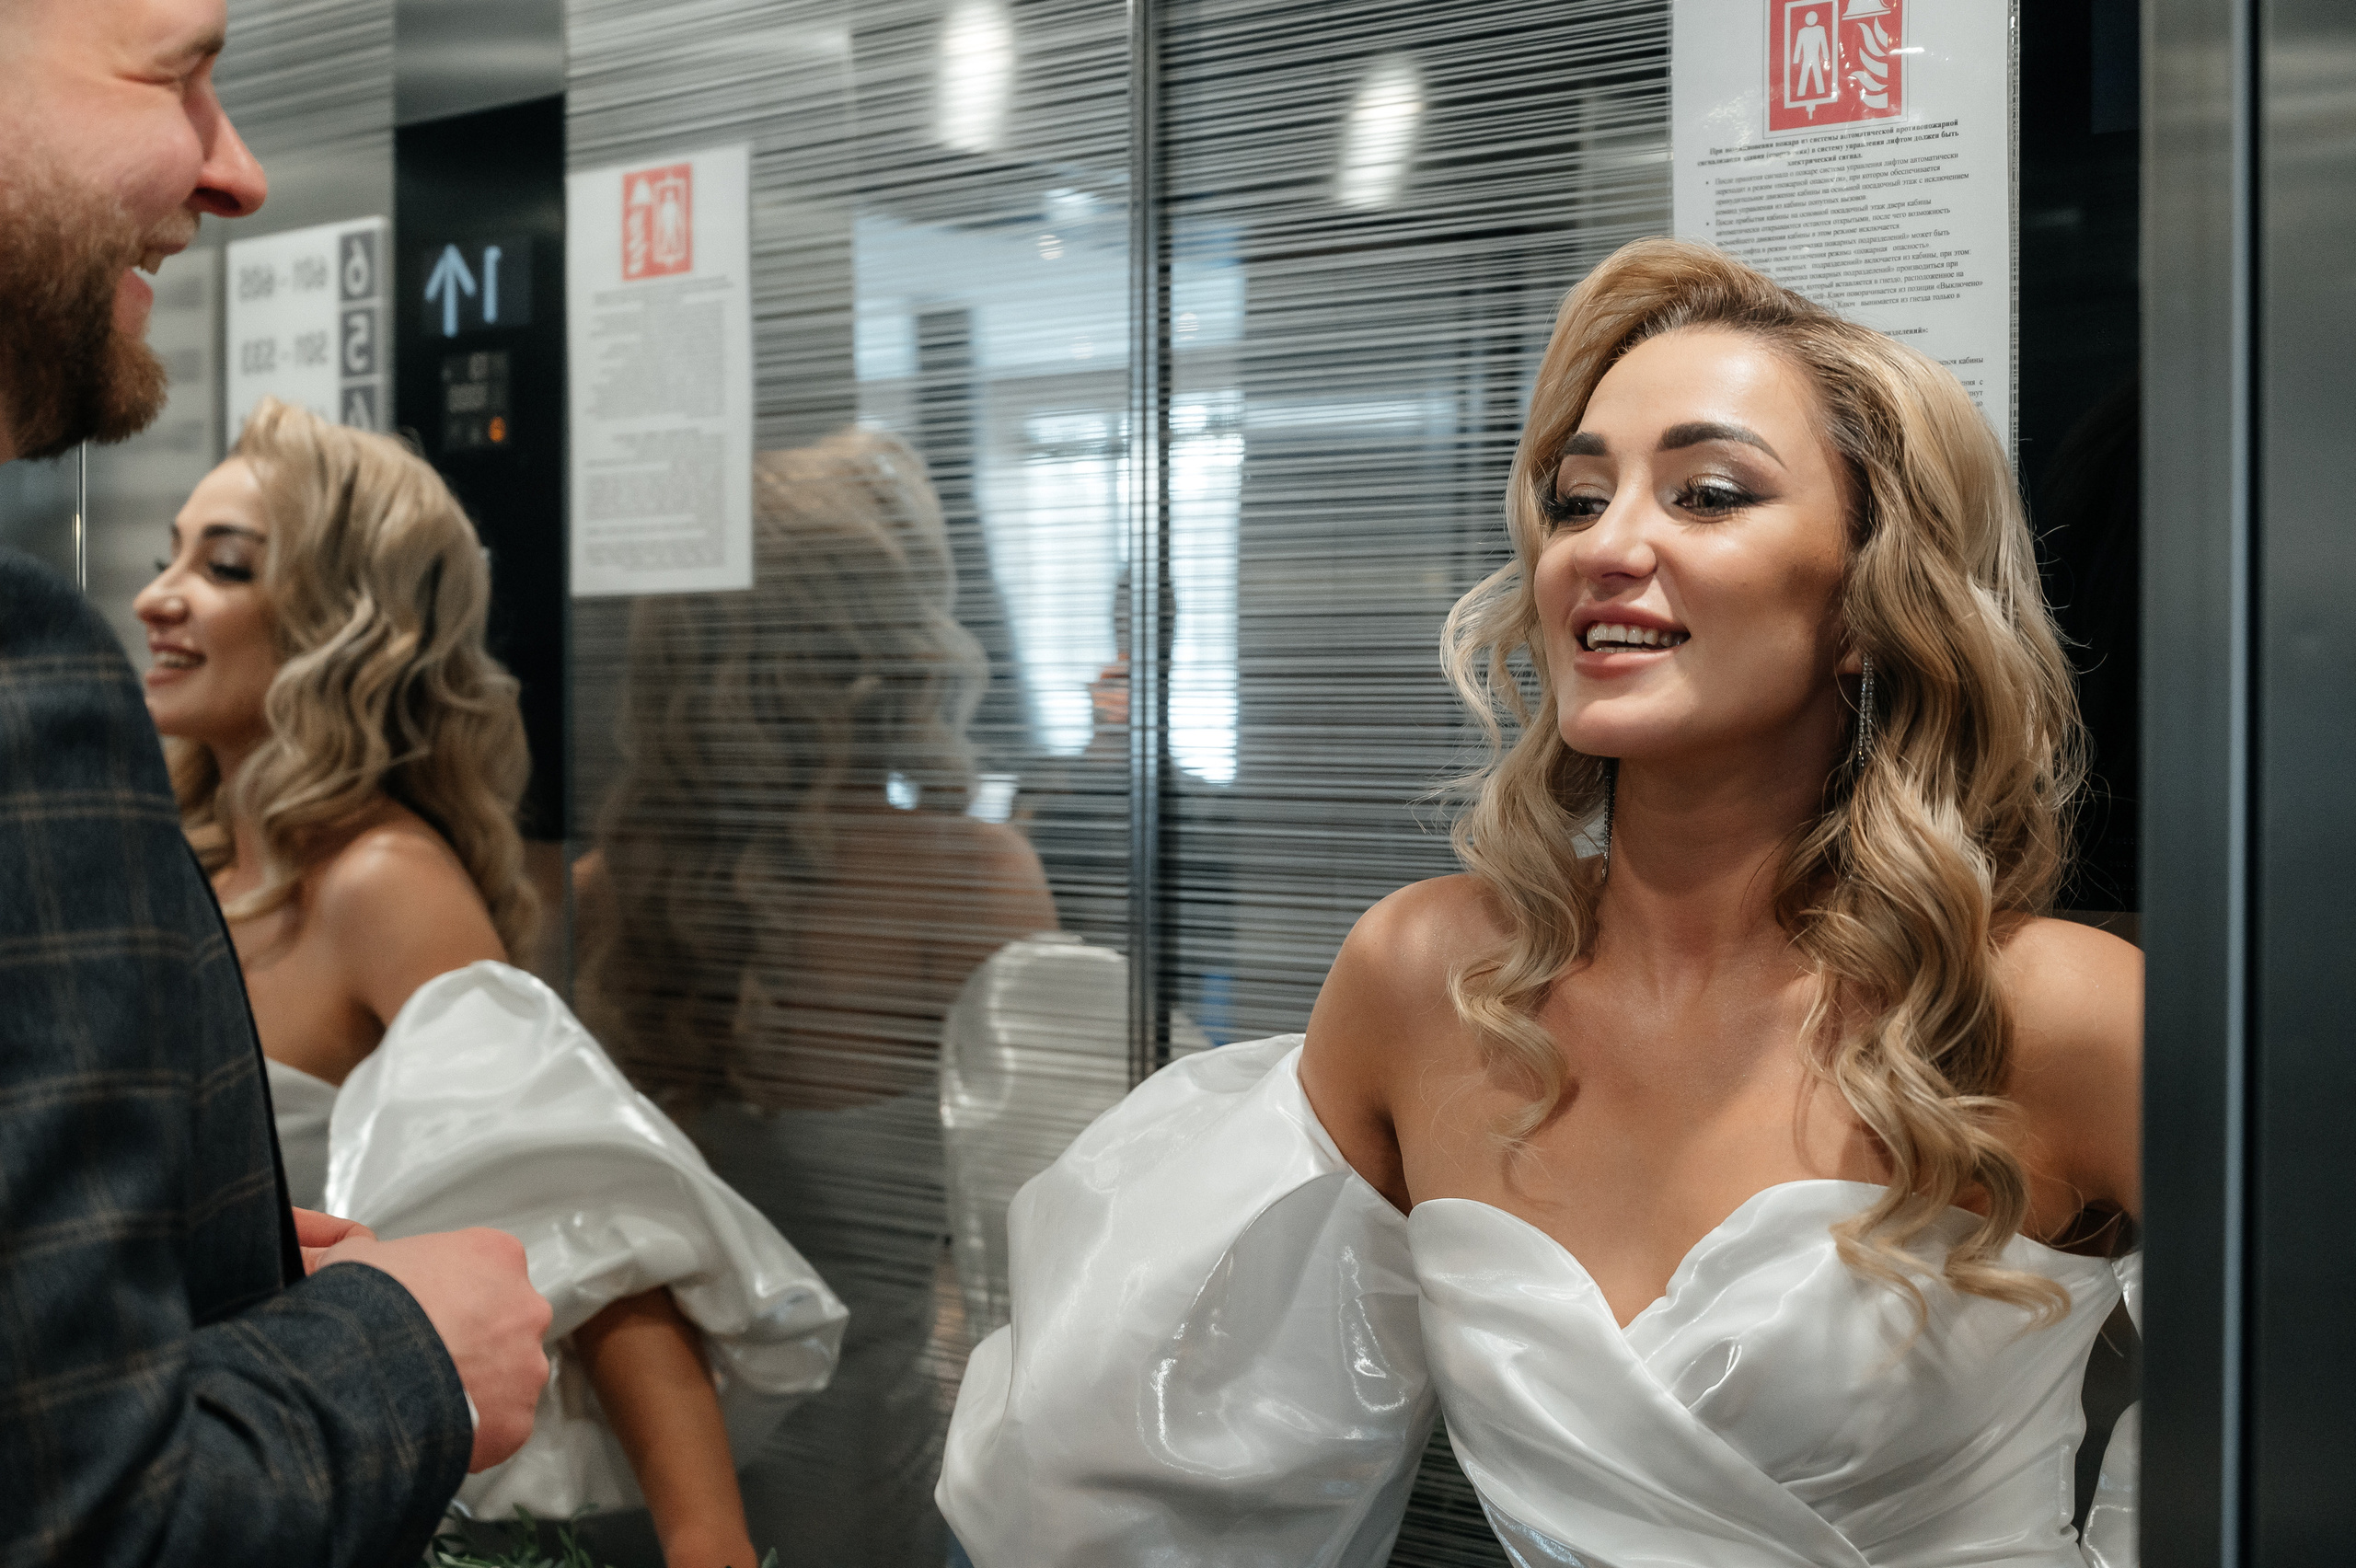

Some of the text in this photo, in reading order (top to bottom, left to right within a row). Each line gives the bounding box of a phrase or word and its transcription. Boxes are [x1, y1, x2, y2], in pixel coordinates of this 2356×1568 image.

[1896, 119, 1958, 134] противопожарной
[1817, 144, 1843, 153] систему
[1887, 136, 1911, 145] лифтом
[1914, 133, 1939, 142] должен
[1884, 158, 1908, 167] лифтом
[1910, 154, 1958, 164] автоматически
[1890, 167, 1941, 177] обеспечивается
[1862, 179, 1900, 190] посадочный
[1924, 174, 1969, 183] исключением
[1908, 209, 1951, 217] возможность
[1911, 252, 1938, 260] кабины,
[1896, 263, 1945, 273] производиться
[1904, 273, 1955, 283] расположенное
[1846, 288, 1897, 297] поворачивается
[1935, 281, 1984, 290] «Выключено»
[1958, 356, 1983, 365] кабины
